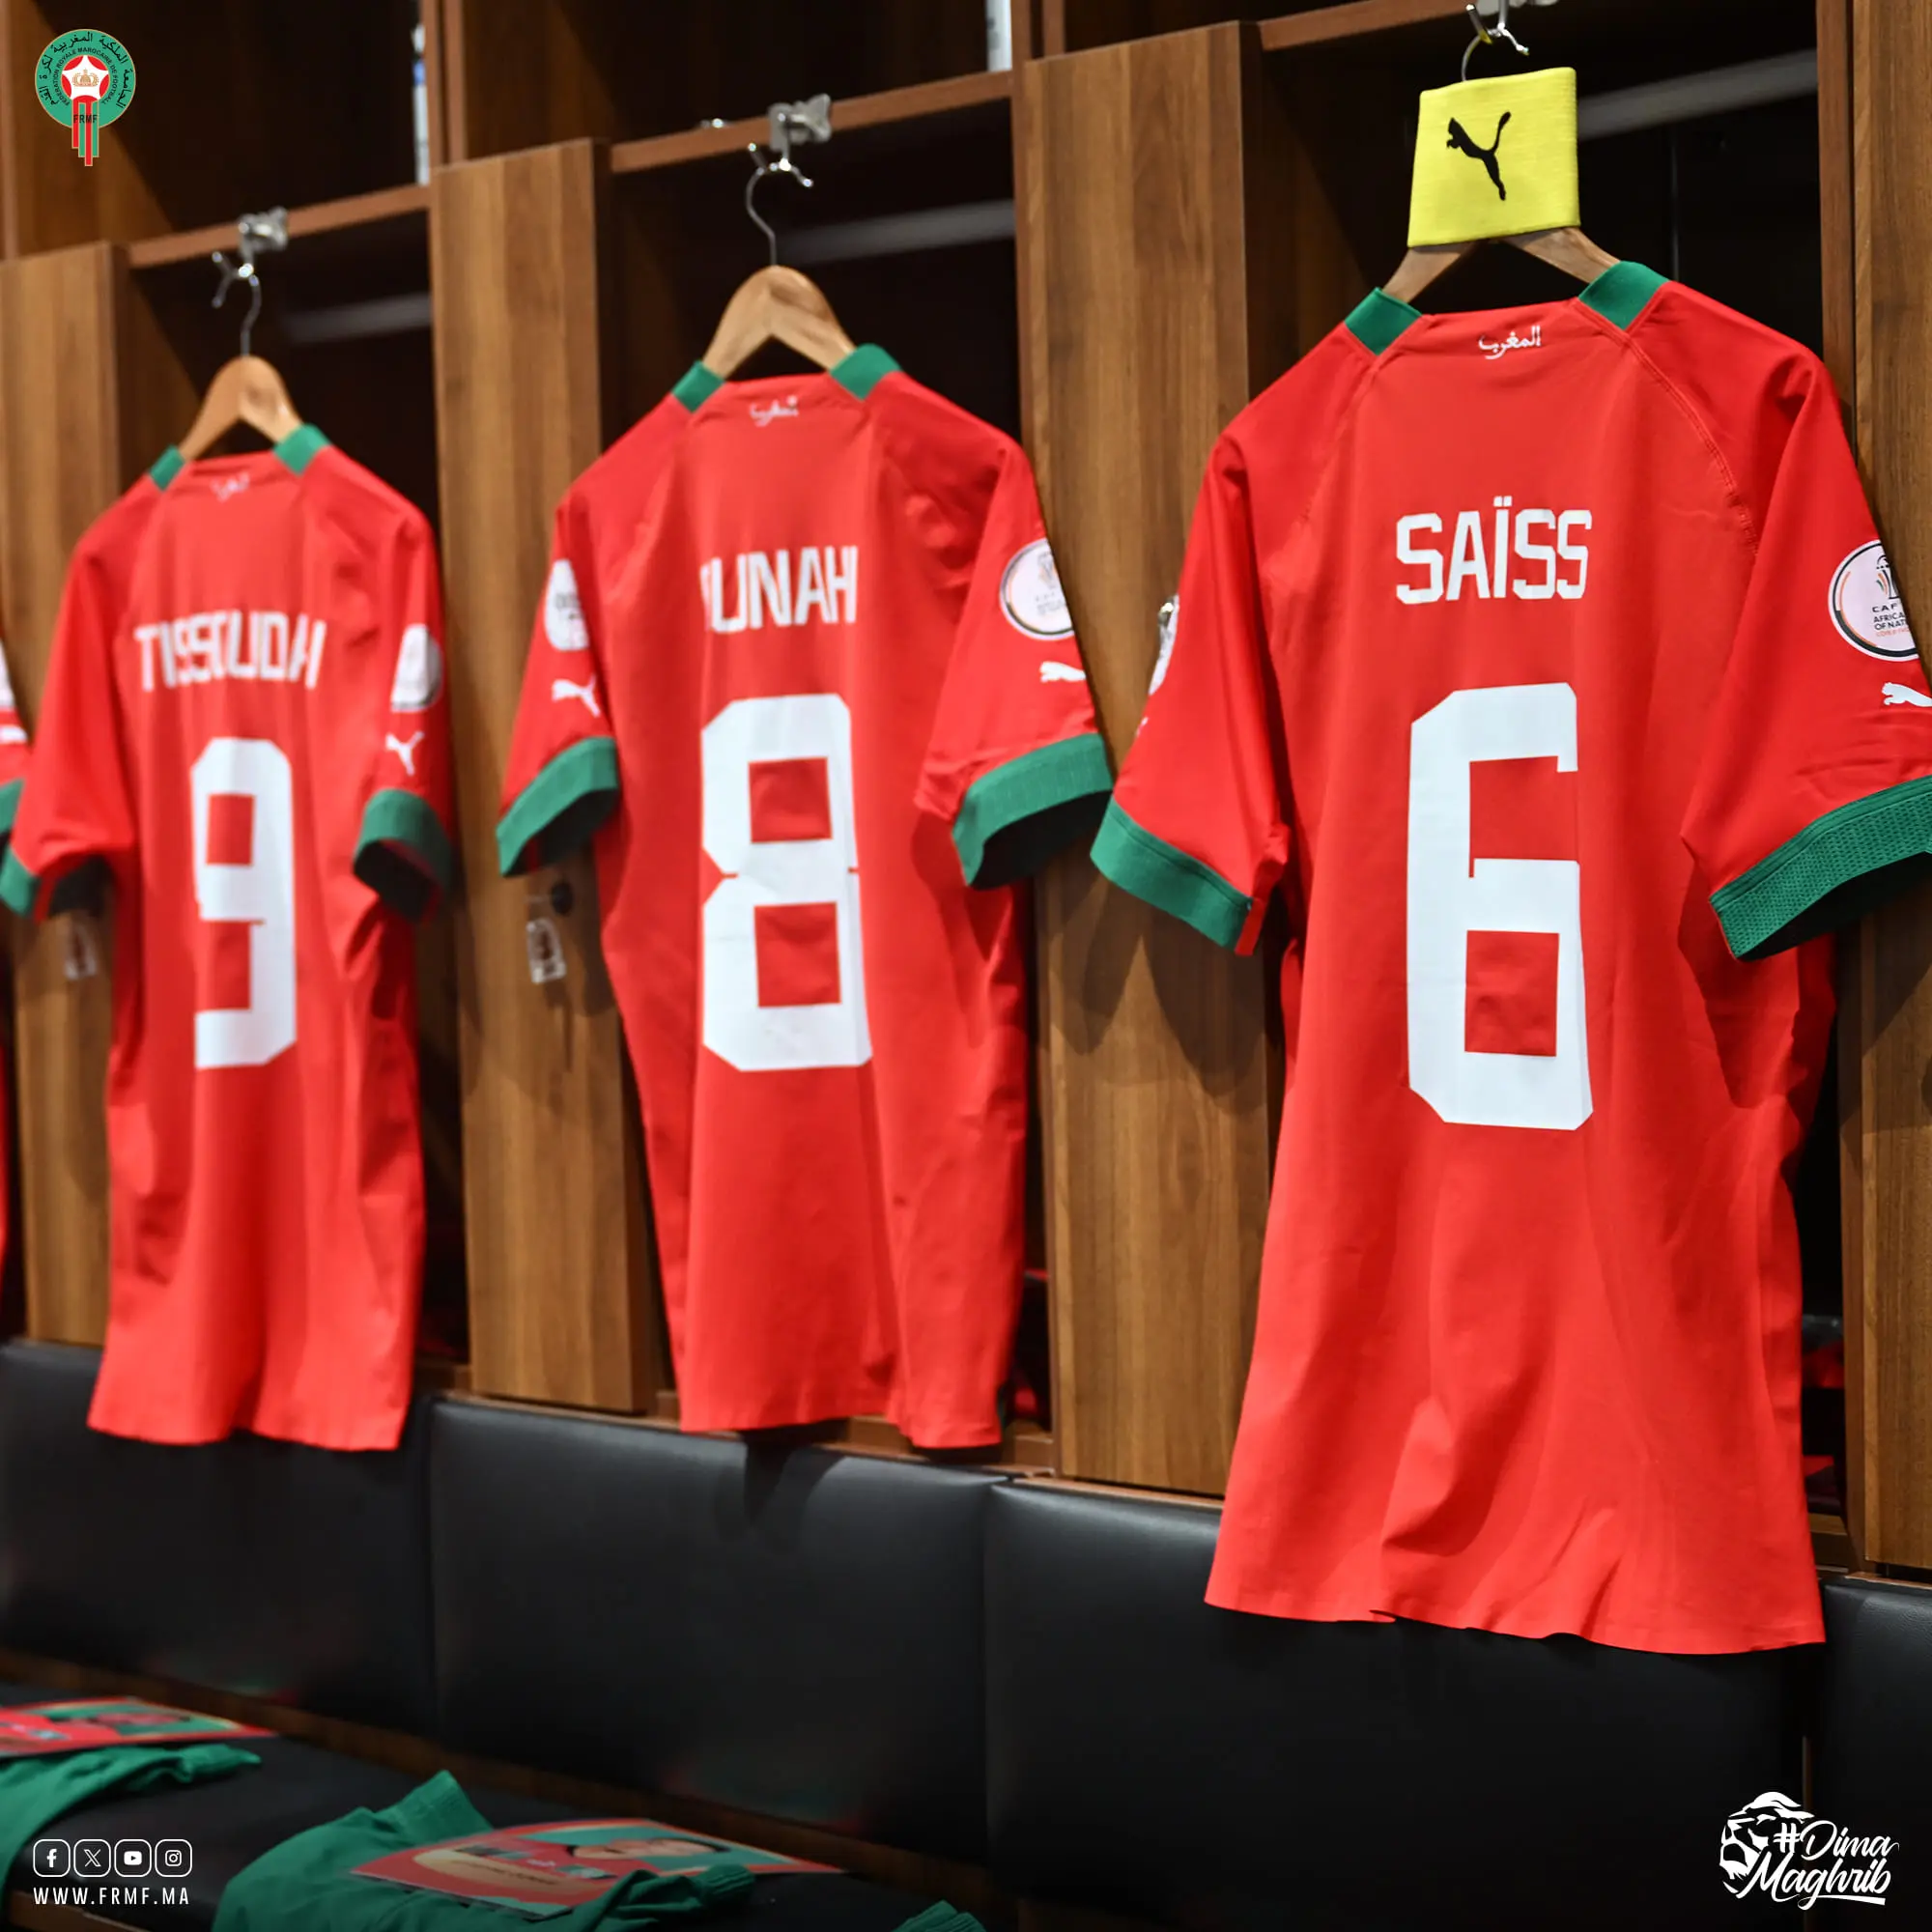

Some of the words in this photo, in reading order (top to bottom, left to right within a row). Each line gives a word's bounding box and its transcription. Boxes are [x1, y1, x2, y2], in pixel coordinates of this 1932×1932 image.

[1478, 325, 1542, 360] المغرب
[1396, 496, 1593, 605] SAÏSS
[1872, 603, 1897, 612] CAF
[189, 736, 298, 1071] 9
[701, 693, 873, 1072] 8
[1406, 682, 1594, 1131] 6
